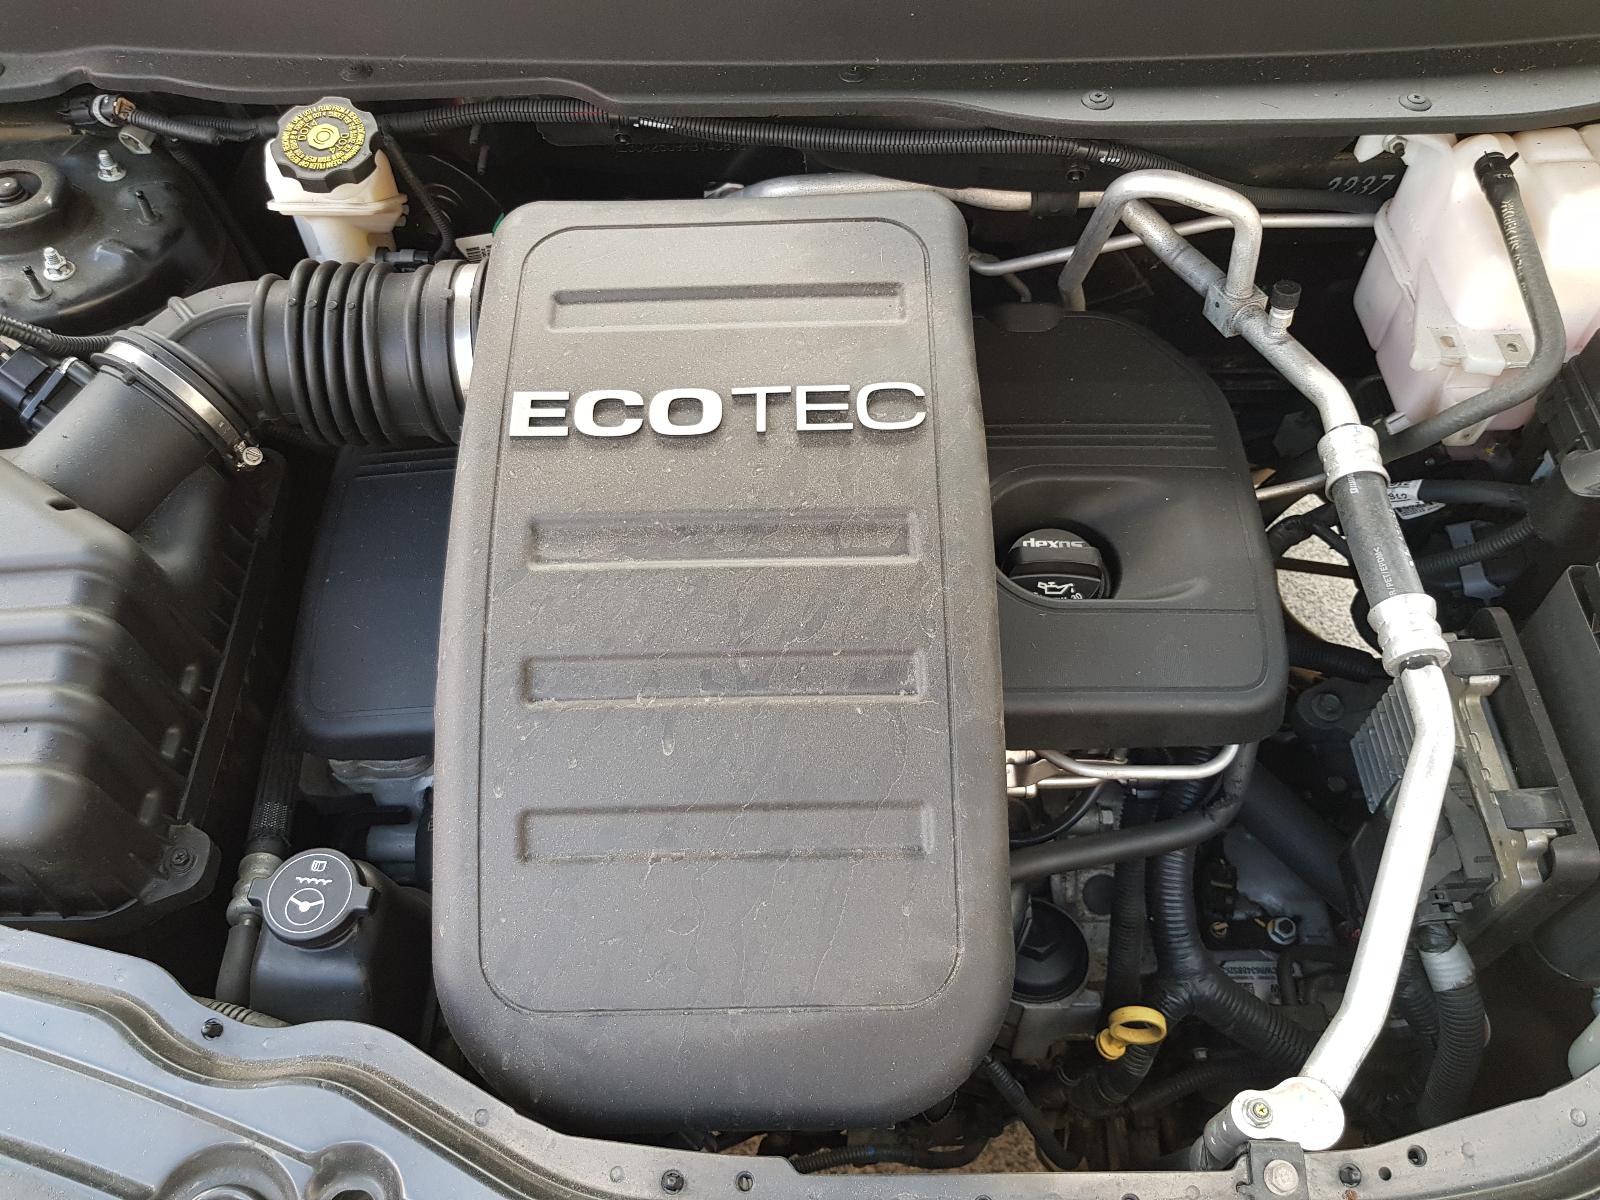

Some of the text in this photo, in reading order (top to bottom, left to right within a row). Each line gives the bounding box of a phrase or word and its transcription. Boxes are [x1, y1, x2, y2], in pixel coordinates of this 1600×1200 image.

[298, 123, 311, 141] DOT
[336, 132, 349, 150] DOT
[509, 381, 927, 437] ECOTEC
[1373, 546, 1397, 597] R/PET/EPDM<
